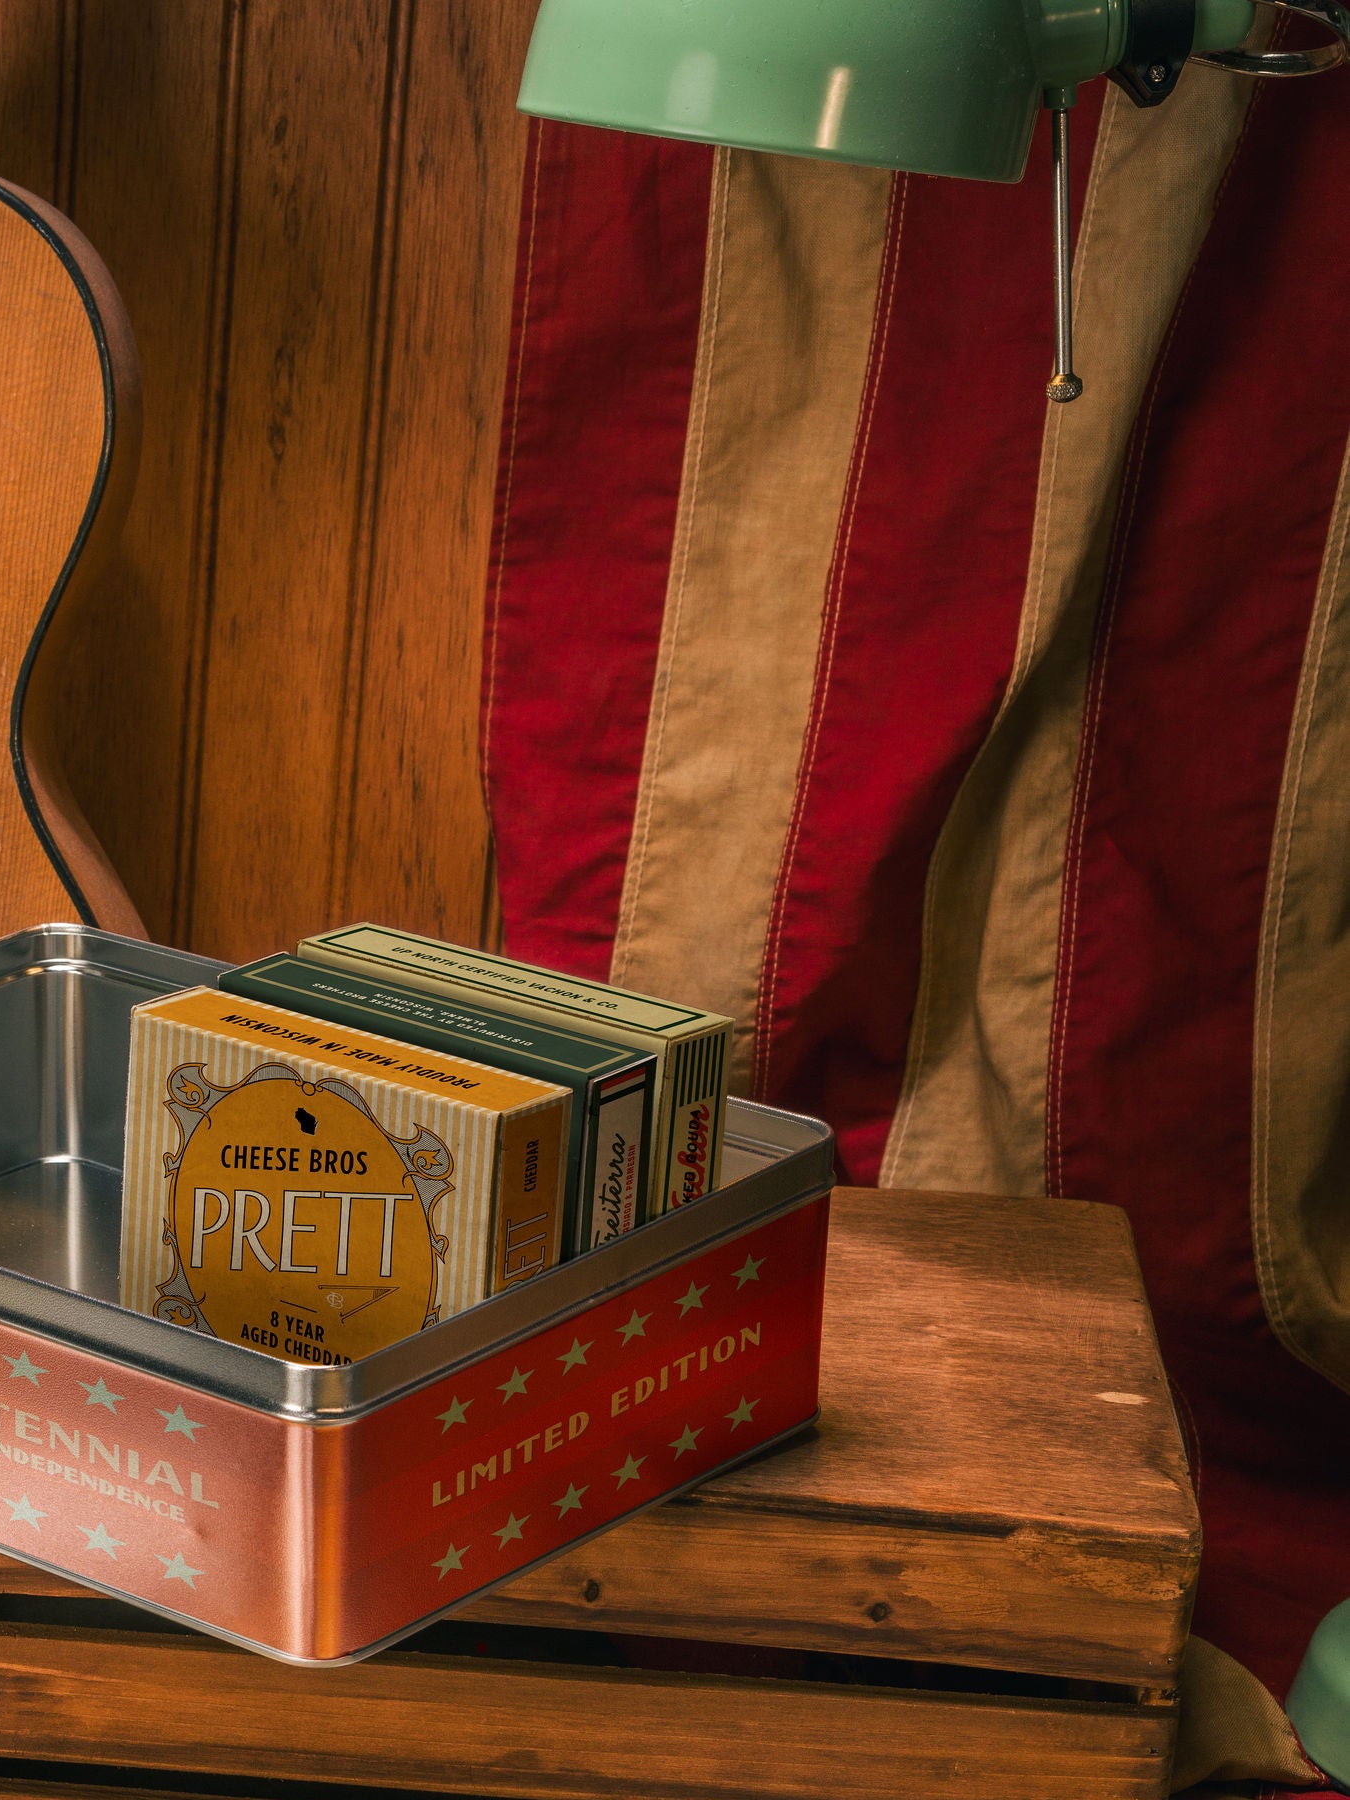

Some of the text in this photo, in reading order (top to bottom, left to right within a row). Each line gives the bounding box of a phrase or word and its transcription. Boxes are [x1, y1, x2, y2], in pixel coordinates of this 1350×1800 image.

[392, 946, 413, 954] UP
[413, 952, 458, 967] NORTH
[458, 963, 527, 986] CERTIFIED
[528, 982, 587, 1000] VACHON
[583, 996, 597, 1004] &
[312, 982, 368, 1001] BROTHERS
[368, 998, 411, 1014] CHEESE
[373, 992, 435, 1013] WISCONSIN
[412, 1010, 437, 1022] THE
[456, 1022, 534, 1047] DISTRIBUTED
[219, 1013, 481, 1092] PROUDLY MADE IN WISCONSIN
[221, 1144, 368, 1175] CHEESE BROS
[523, 1138, 540, 1193] CHEDDAR
[625, 1144, 636, 1192] PARMESAN
[681, 1109, 702, 1203] KED GOUDA
[190, 1187, 414, 1278] PRETT
[240, 1323, 278, 1349] AGED
[270, 1311, 325, 1343] 8 YEAR
[431, 1322, 763, 1507] LIMITED EDITION
